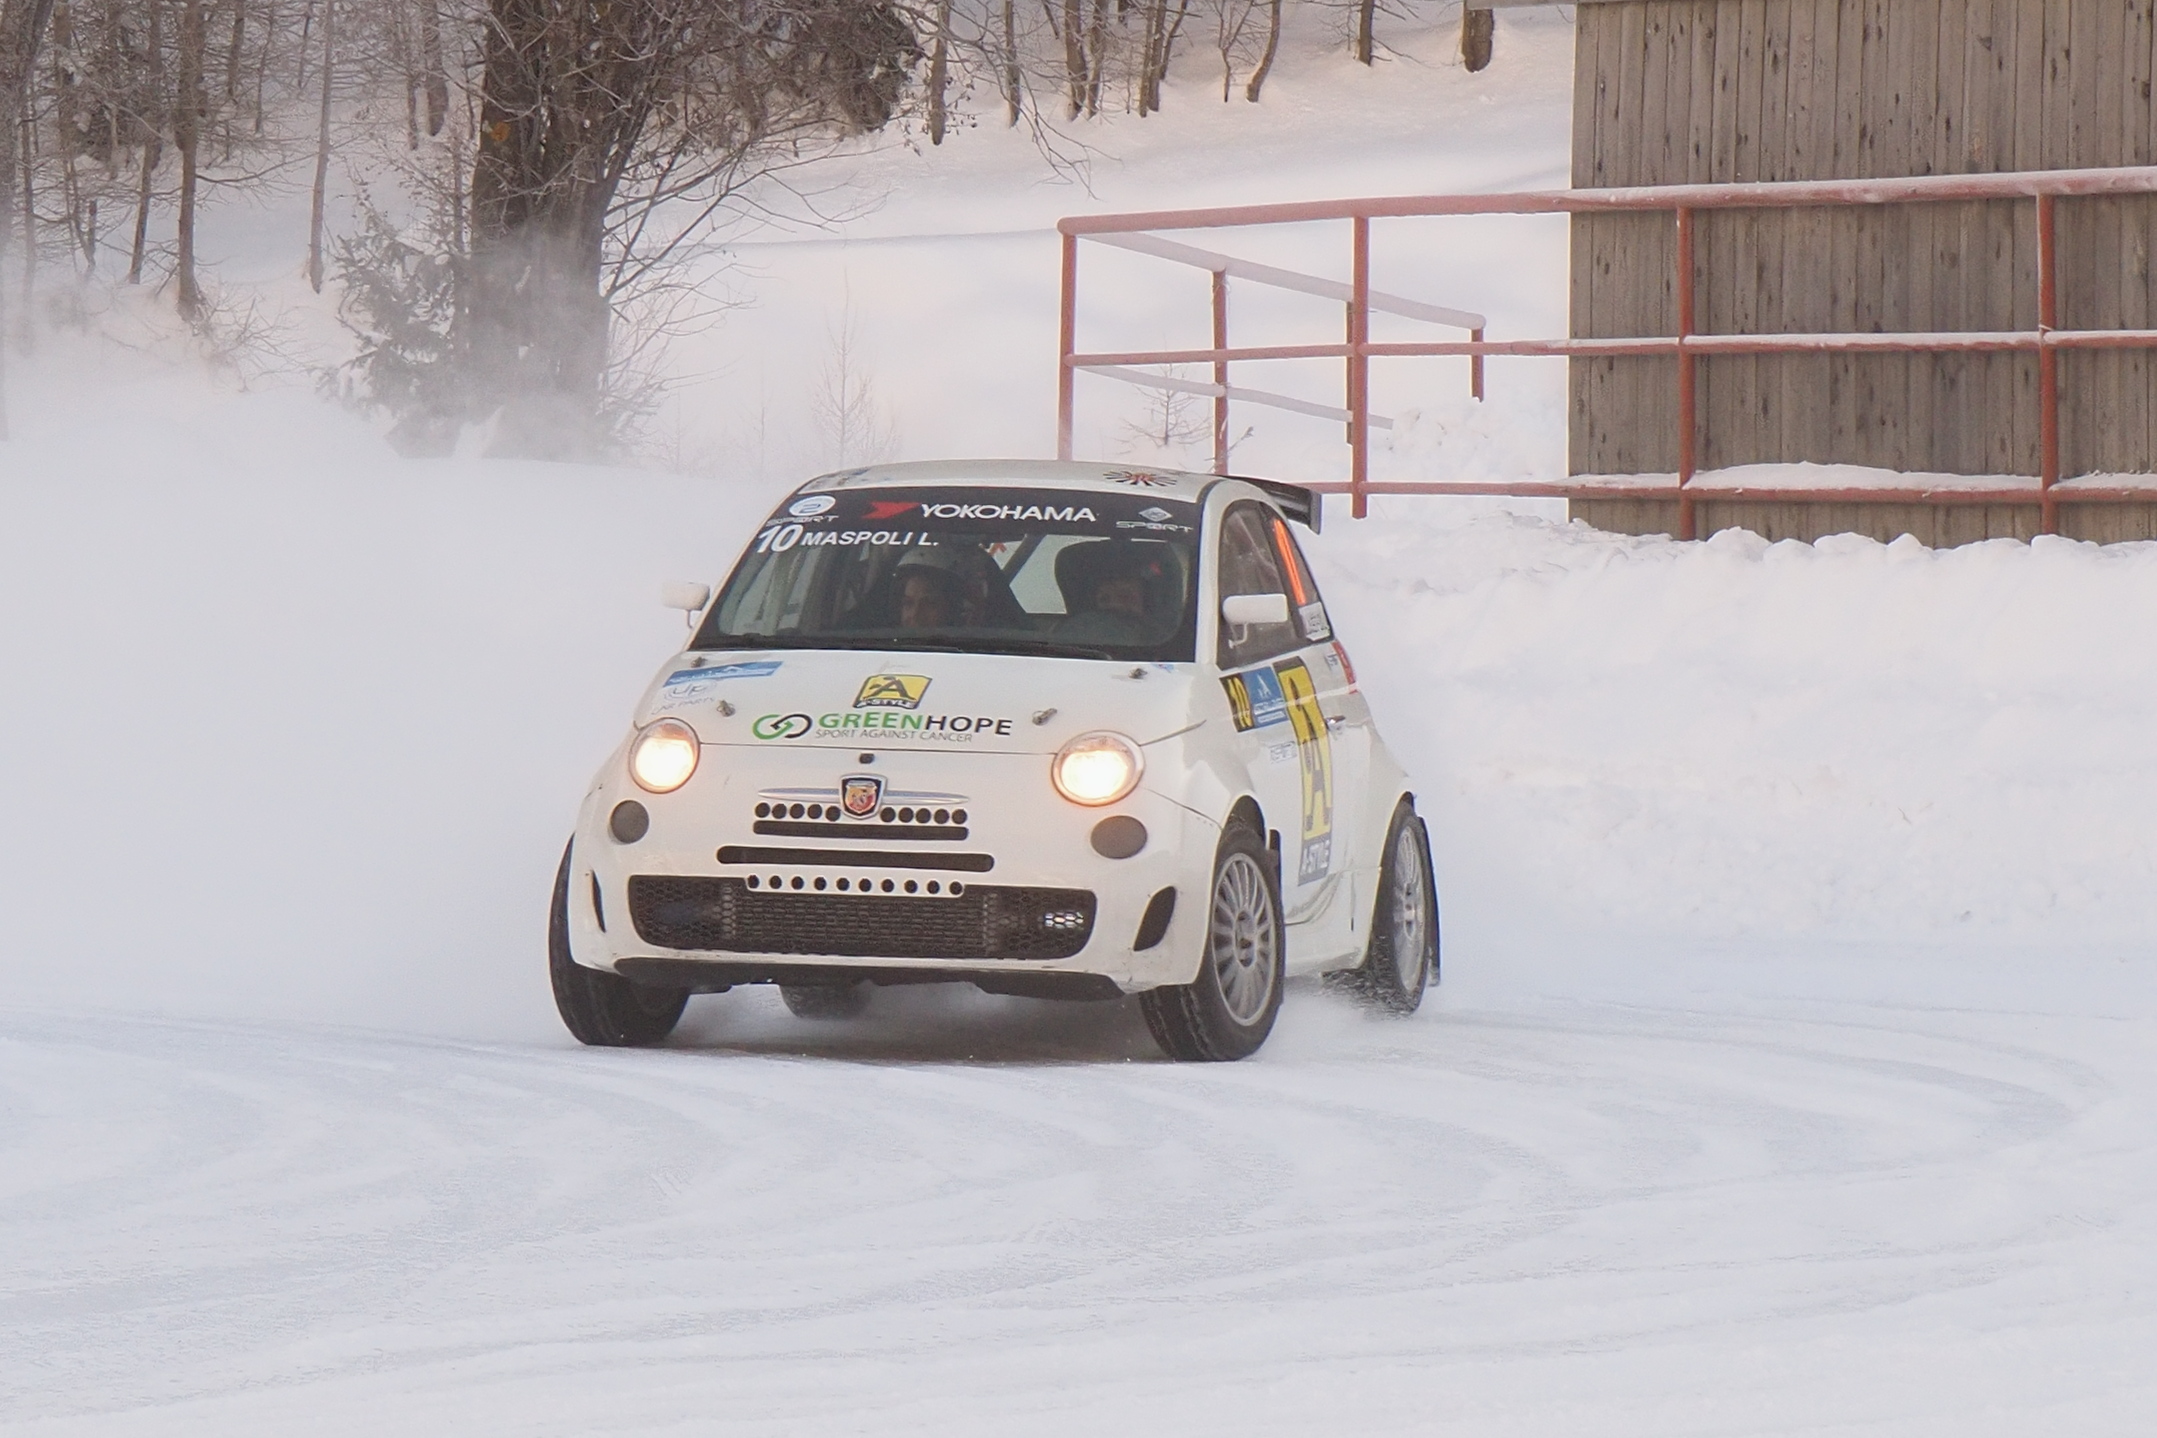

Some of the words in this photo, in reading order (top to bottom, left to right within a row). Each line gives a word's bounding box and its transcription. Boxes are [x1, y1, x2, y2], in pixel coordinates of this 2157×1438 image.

[766, 515, 840, 527] SPORT
[921, 503, 1097, 523] YOKOHAMA
[1115, 520, 1195, 533] SPORT
[757, 524, 804, 554] 10
[801, 531, 914, 547] MASPOLI
[918, 532, 940, 547] L.
[818, 711, 1013, 737] GREENHOPE
[814, 728, 858, 740] SPORT
[860, 728, 916, 740] AGAINST
[919, 730, 973, 743] CANCER
